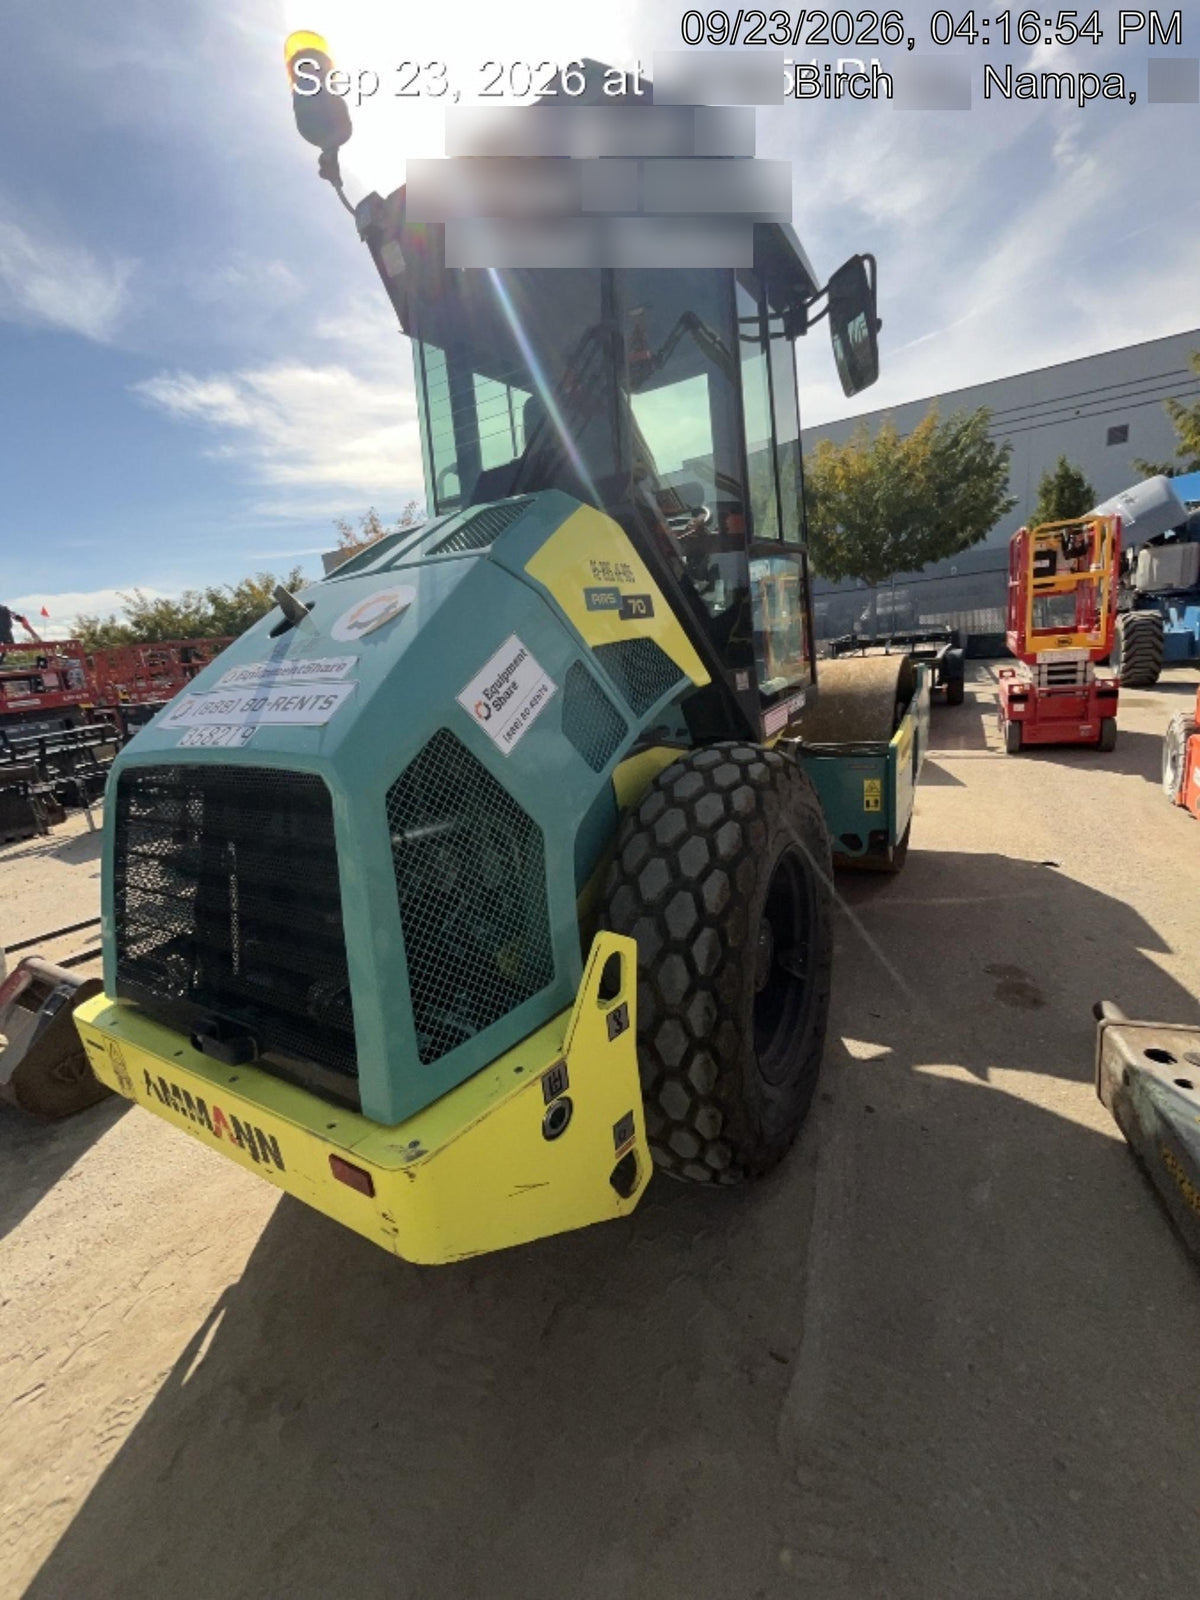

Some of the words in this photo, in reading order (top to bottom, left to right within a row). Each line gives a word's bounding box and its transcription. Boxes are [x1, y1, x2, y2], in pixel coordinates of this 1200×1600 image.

[627, 598, 647, 615] 70
[482, 649, 528, 701] Equipment
[492, 681, 519, 712] Share
[143, 1068, 286, 1172] AMMANN
